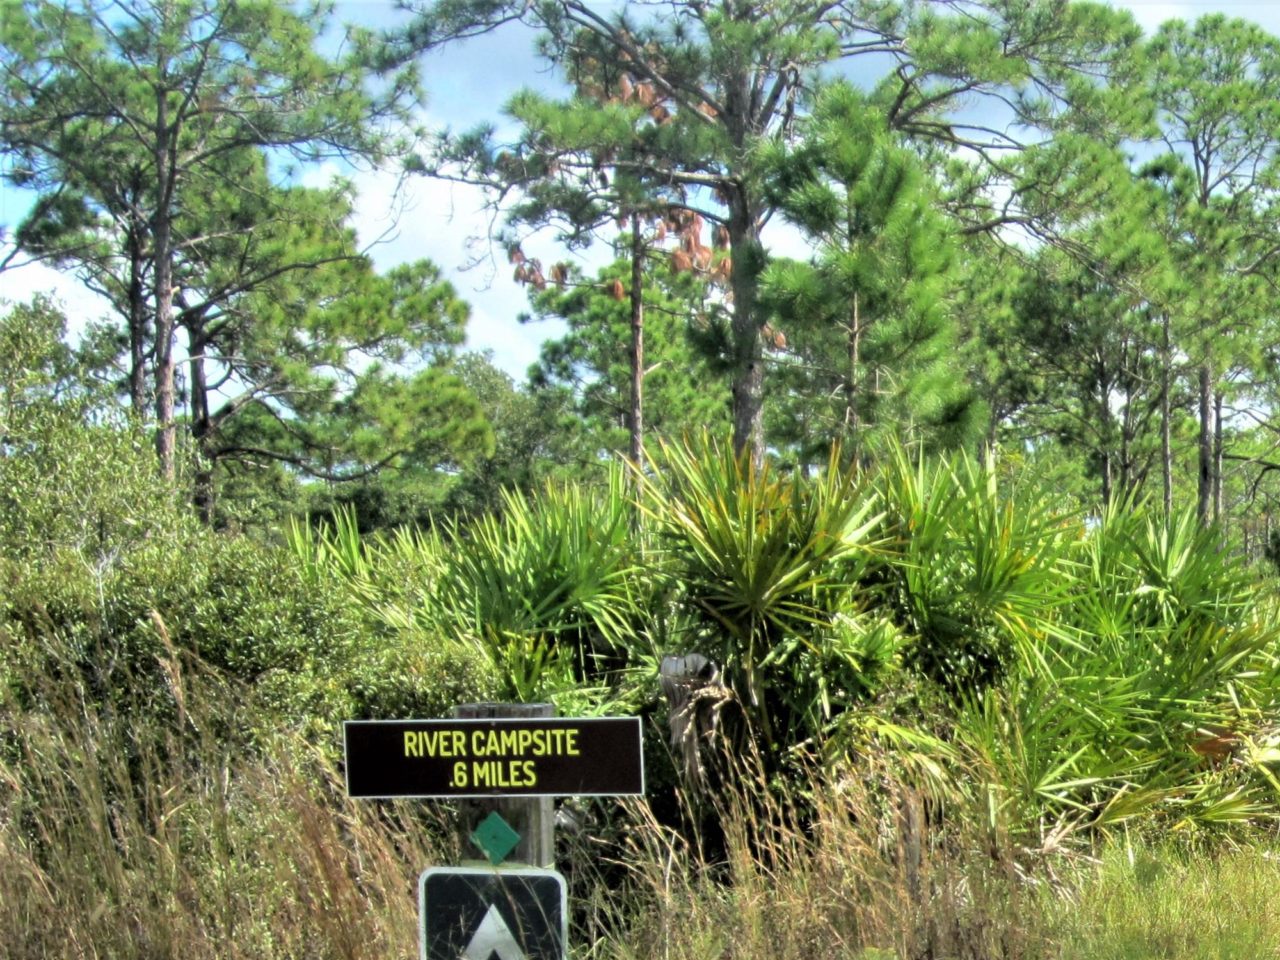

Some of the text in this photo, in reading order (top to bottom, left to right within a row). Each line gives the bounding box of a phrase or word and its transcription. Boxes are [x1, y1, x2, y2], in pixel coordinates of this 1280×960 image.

[404, 728, 580, 757] RIVER CAMPSITE
[449, 760, 537, 788] .6 MILES
